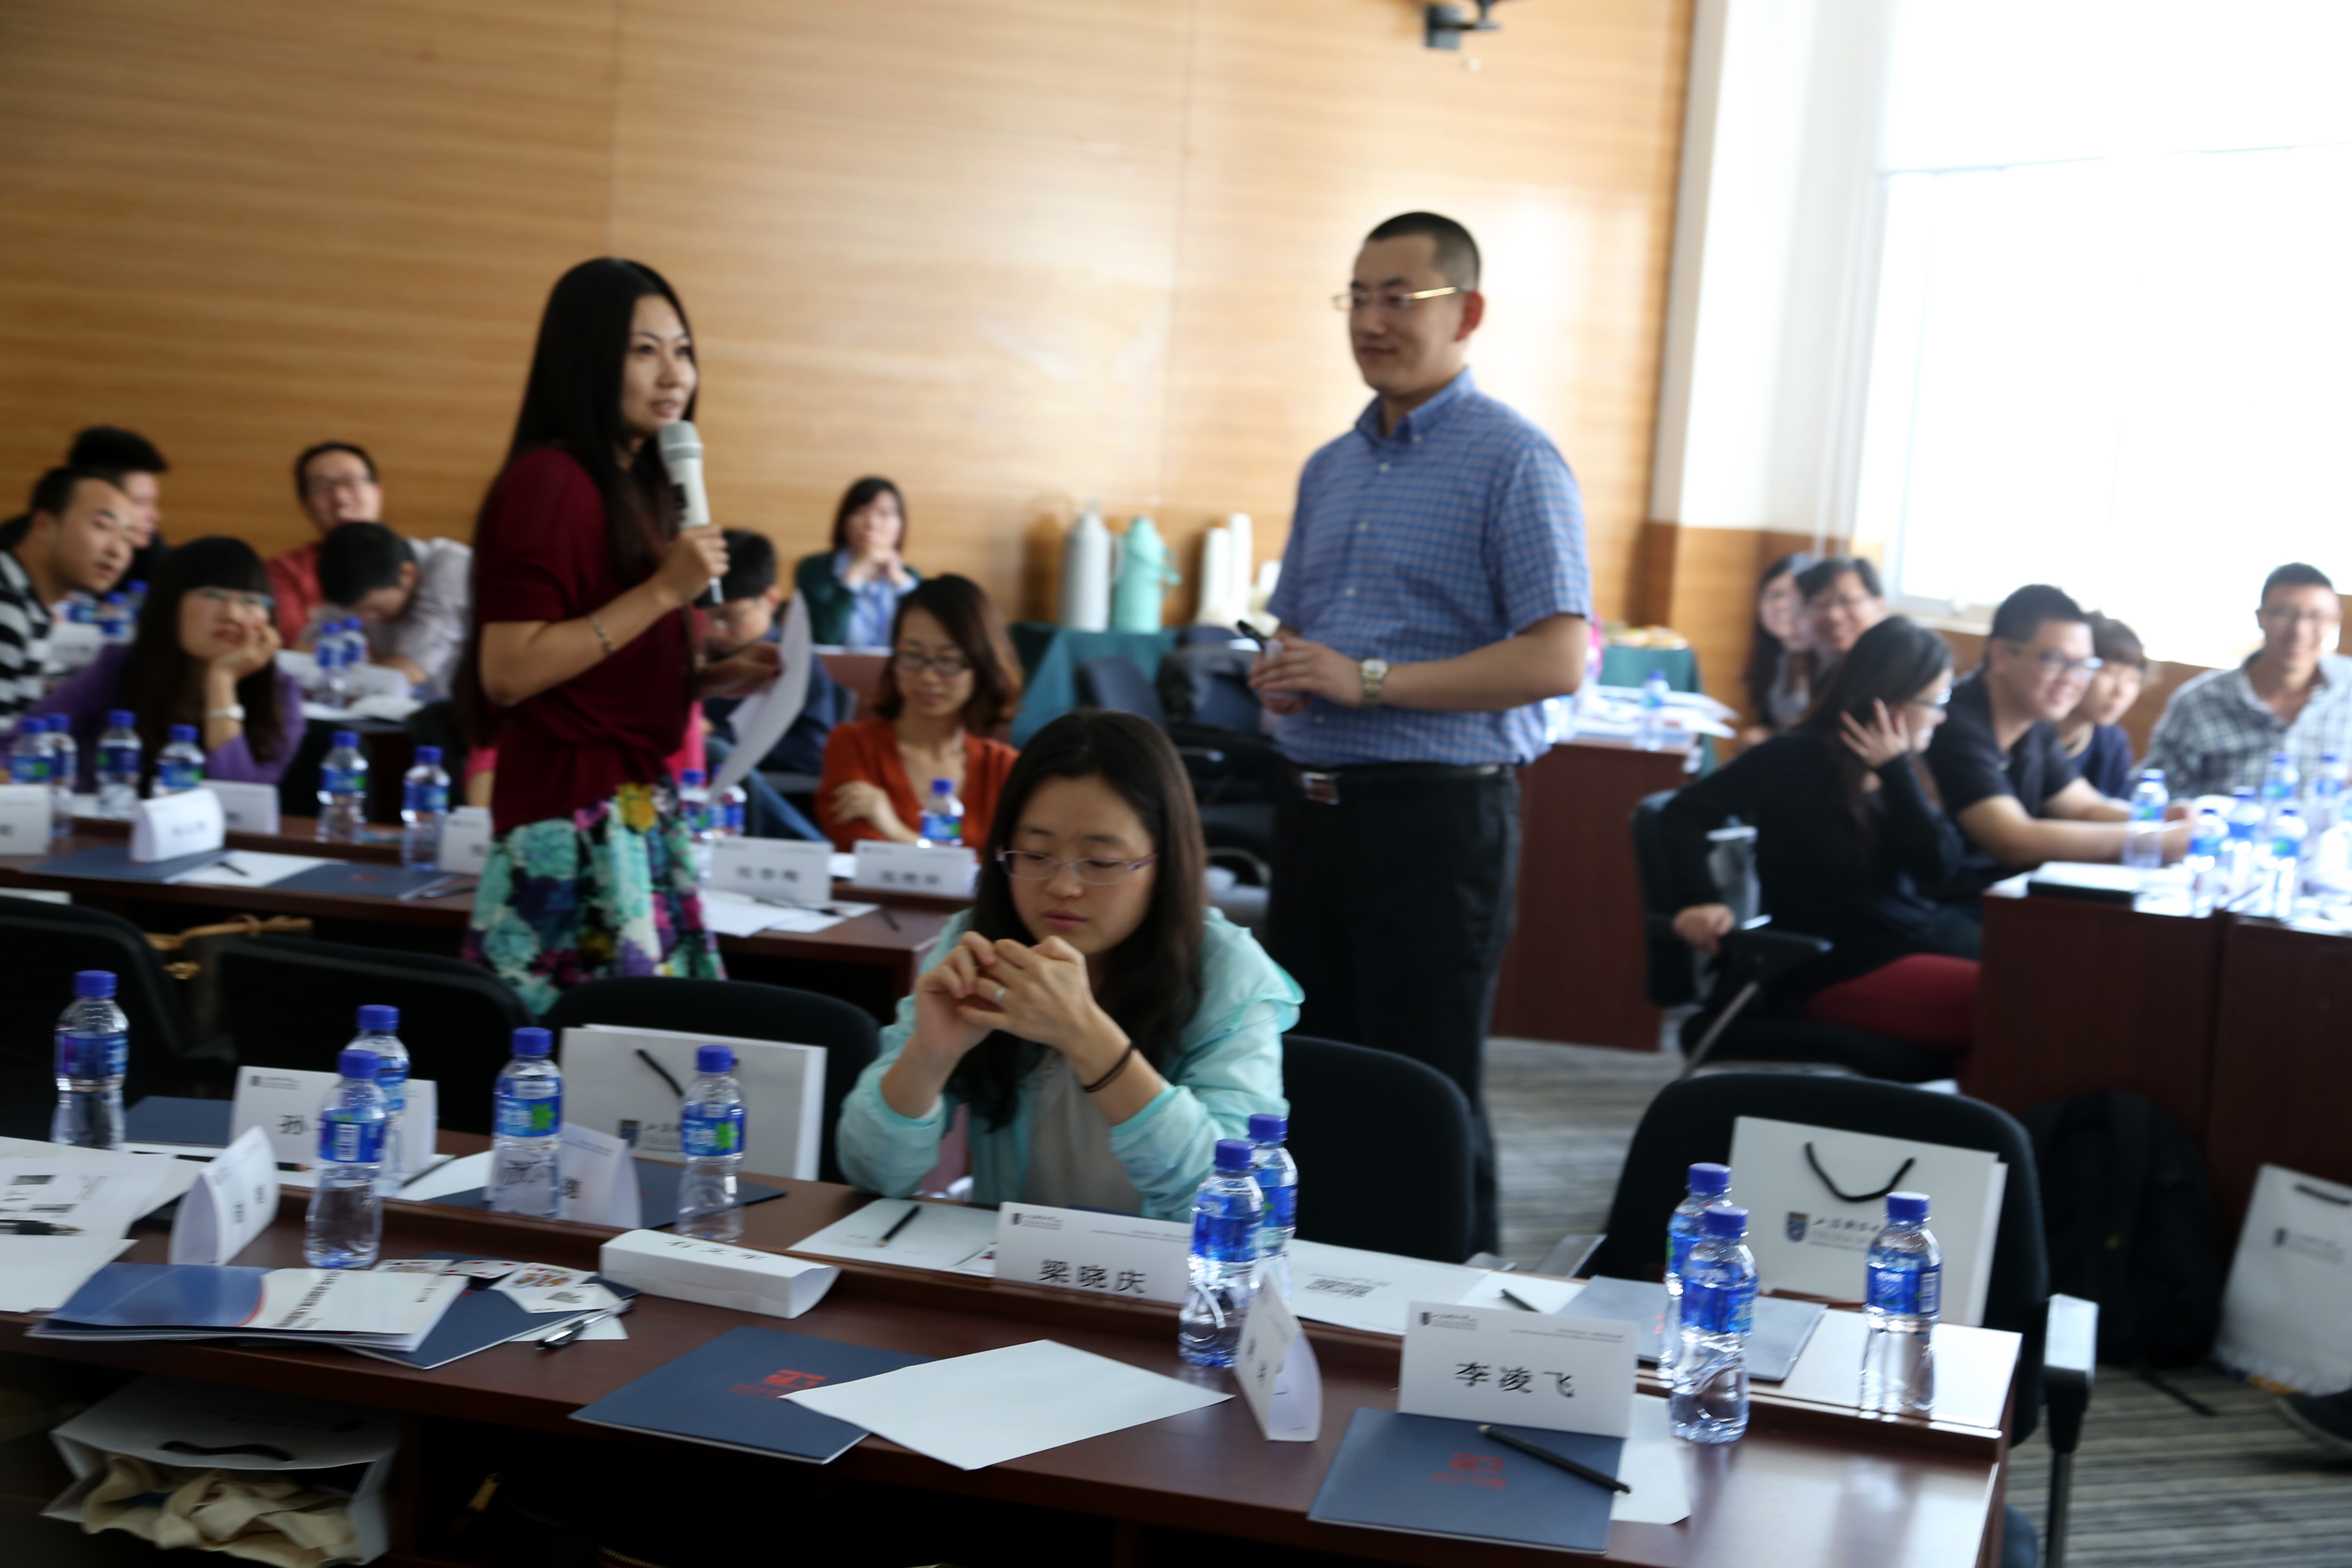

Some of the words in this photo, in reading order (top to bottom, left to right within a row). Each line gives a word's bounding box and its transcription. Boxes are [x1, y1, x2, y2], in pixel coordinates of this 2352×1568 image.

[1038, 1259, 1146, 1294] 梁晓庆
[1455, 1361, 1575, 1398] 李凌飞
